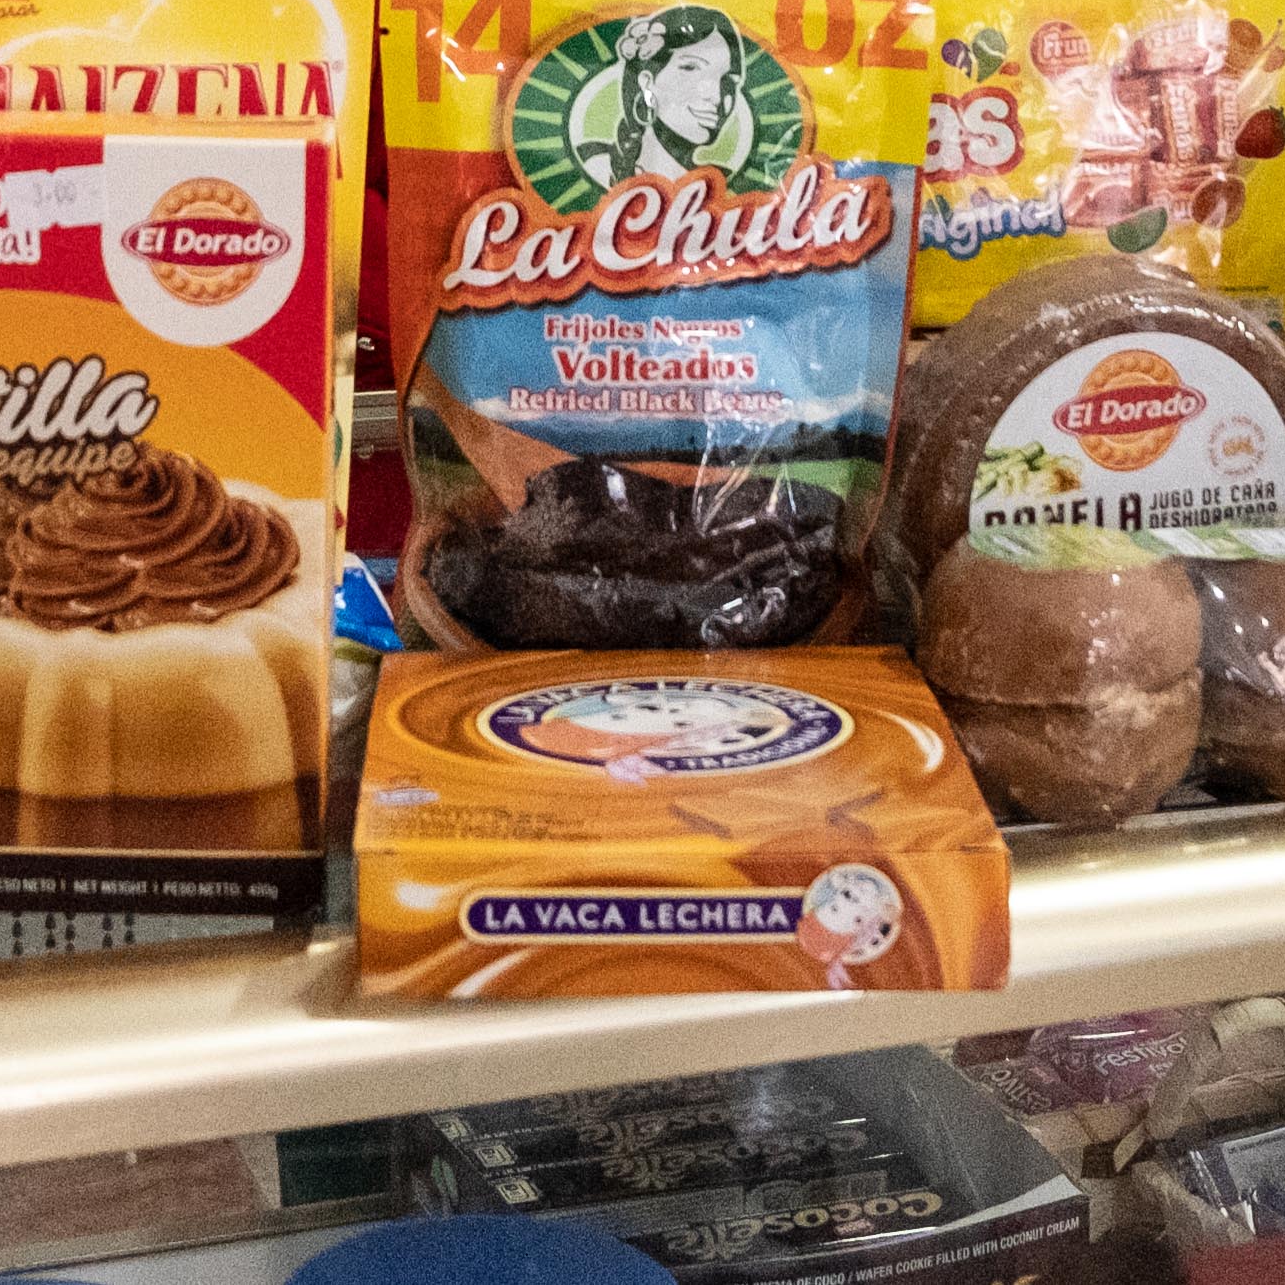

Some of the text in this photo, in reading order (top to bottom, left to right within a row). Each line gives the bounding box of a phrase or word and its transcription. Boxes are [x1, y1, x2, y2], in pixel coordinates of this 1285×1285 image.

[136, 227, 282, 256] El Dorado
[443, 163, 871, 291] La Chula
[544, 315, 646, 345] Frijoles
[553, 347, 756, 385] Volteados
[510, 386, 782, 415] Refried Black Beans
[1067, 395, 1198, 428] El Dorado
[1150, 490, 1194, 510] JUGO
[1203, 486, 1221, 503] DE
[485, 902, 790, 932] LA VACA LECHERA
[856, 1264, 893, 1282] WAFER
[896, 1257, 933, 1273] COOKIE
[935, 1247, 970, 1266] FILLED
[972, 1239, 998, 1258] WITH
[999, 1227, 1046, 1249] COCONUT
[1046, 1217, 1081, 1240] CREAM
